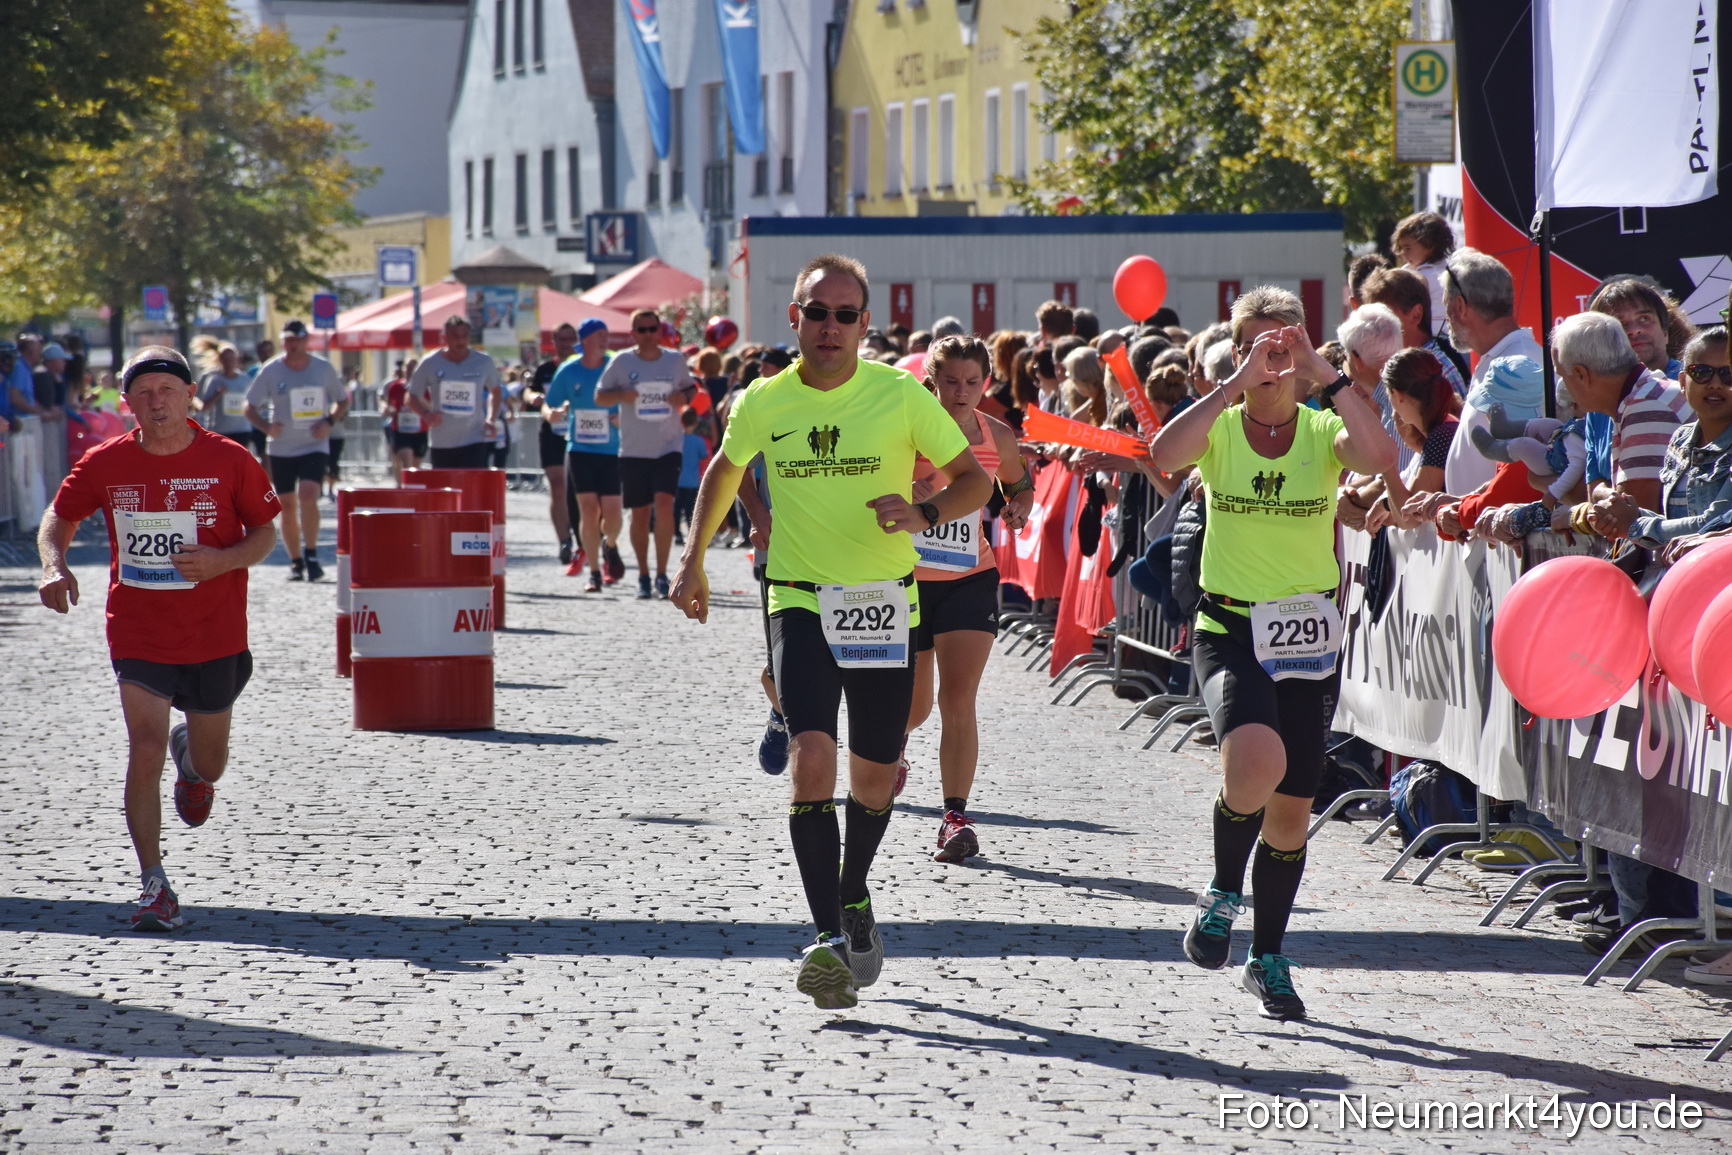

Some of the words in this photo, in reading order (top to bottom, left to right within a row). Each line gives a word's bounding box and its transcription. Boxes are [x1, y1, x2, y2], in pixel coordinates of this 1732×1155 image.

[1067, 422, 1120, 449] DEHN
[1212, 490, 1223, 501] SC
[134, 519, 171, 527] BOCK
[127, 533, 184, 557] 2286
[918, 549, 948, 562] Melanie
[138, 570, 174, 581] Norbert
[844, 590, 884, 601] BOCK
[1279, 601, 1318, 612] BOCK
[833, 604, 895, 631] 2292
[1267, 616, 1329, 648] 2291
[841, 647, 888, 660] Benjamin
[821, 802, 836, 813] ce
